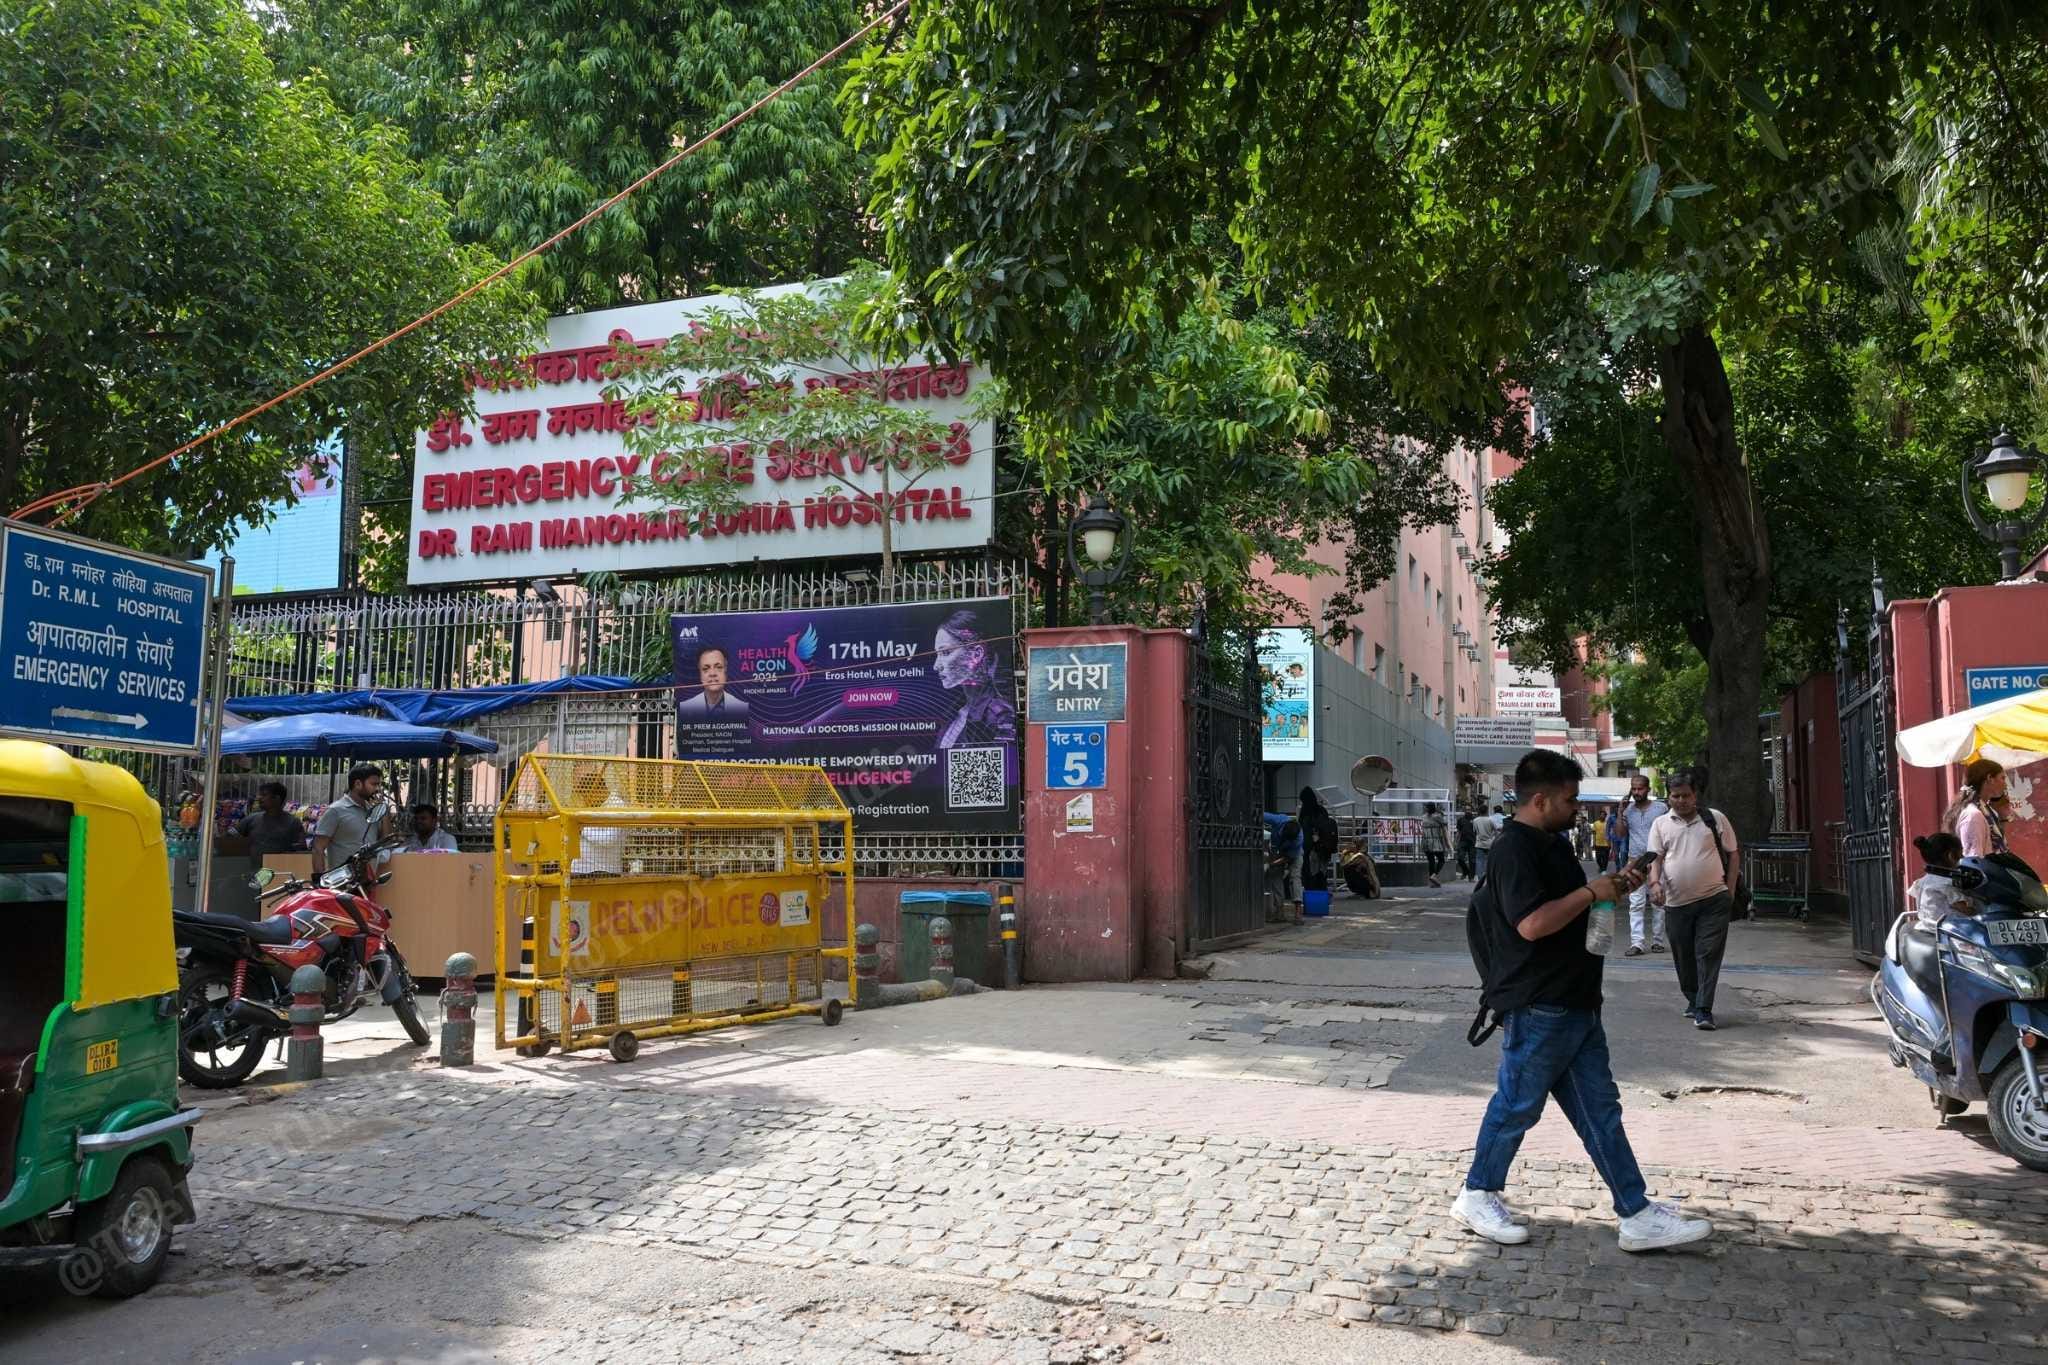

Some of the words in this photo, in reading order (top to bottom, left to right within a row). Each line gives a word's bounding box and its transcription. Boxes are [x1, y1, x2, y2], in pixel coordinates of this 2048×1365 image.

[482, 409, 540, 445] राम
[423, 454, 641, 513] EMERGENCY
[471, 521, 533, 555] RAM
[540, 509, 689, 550] MANOHAR
[698, 499, 796, 538] LOHIA
[44, 556, 64, 575] राम
[72, 561, 106, 584] मनोहर
[112, 568, 146, 593] लोहिया
[153, 581, 193, 604] अस्पताल
[32, 580, 51, 598] Dr.
[117, 597, 183, 624] HOSPITAL
[26, 620, 128, 660] आपातकालीन
[738, 647, 787, 660] HEALTH
[828, 640, 871, 660] 17th
[876, 640, 917, 661] May
[756, 659, 786, 671] CON
[825, 671, 845, 680] Eros
[847, 669, 875, 680] Hotel,
[876, 669, 898, 678] New
[899, 667, 925, 678] Delhi
[1045, 653, 1111, 691] प्रवेश
[13, 655, 110, 690] EMERGENCY
[117, 670, 186, 702] SERVICES
[1971, 676, 2008, 690] GATE
[2013, 675, 2036, 689] NO.
[847, 693, 868, 703] JOIN
[870, 692, 892, 702] NOW
[1056, 697, 1102, 712] ENTRY
[712, 722, 748, 730] AGGARWAL
[763, 725, 805, 735] NATIONAL
[807, 726, 816, 734] AI
[818, 724, 859, 734] DOCTORS
[862, 723, 898, 733] MISSION
[900, 722, 936, 732] (NAIDM)
[1051, 729, 1070, 746] गेट
[1072, 732, 1086, 745] न.
[780, 757, 810, 767] MUST
[813, 757, 828, 768] BE
[830, 755, 903, 767] EMPOWERED
[907, 754, 937, 765] WITH
[1063, 752, 1089, 786] 5
[858, 804, 929, 817] Registration
